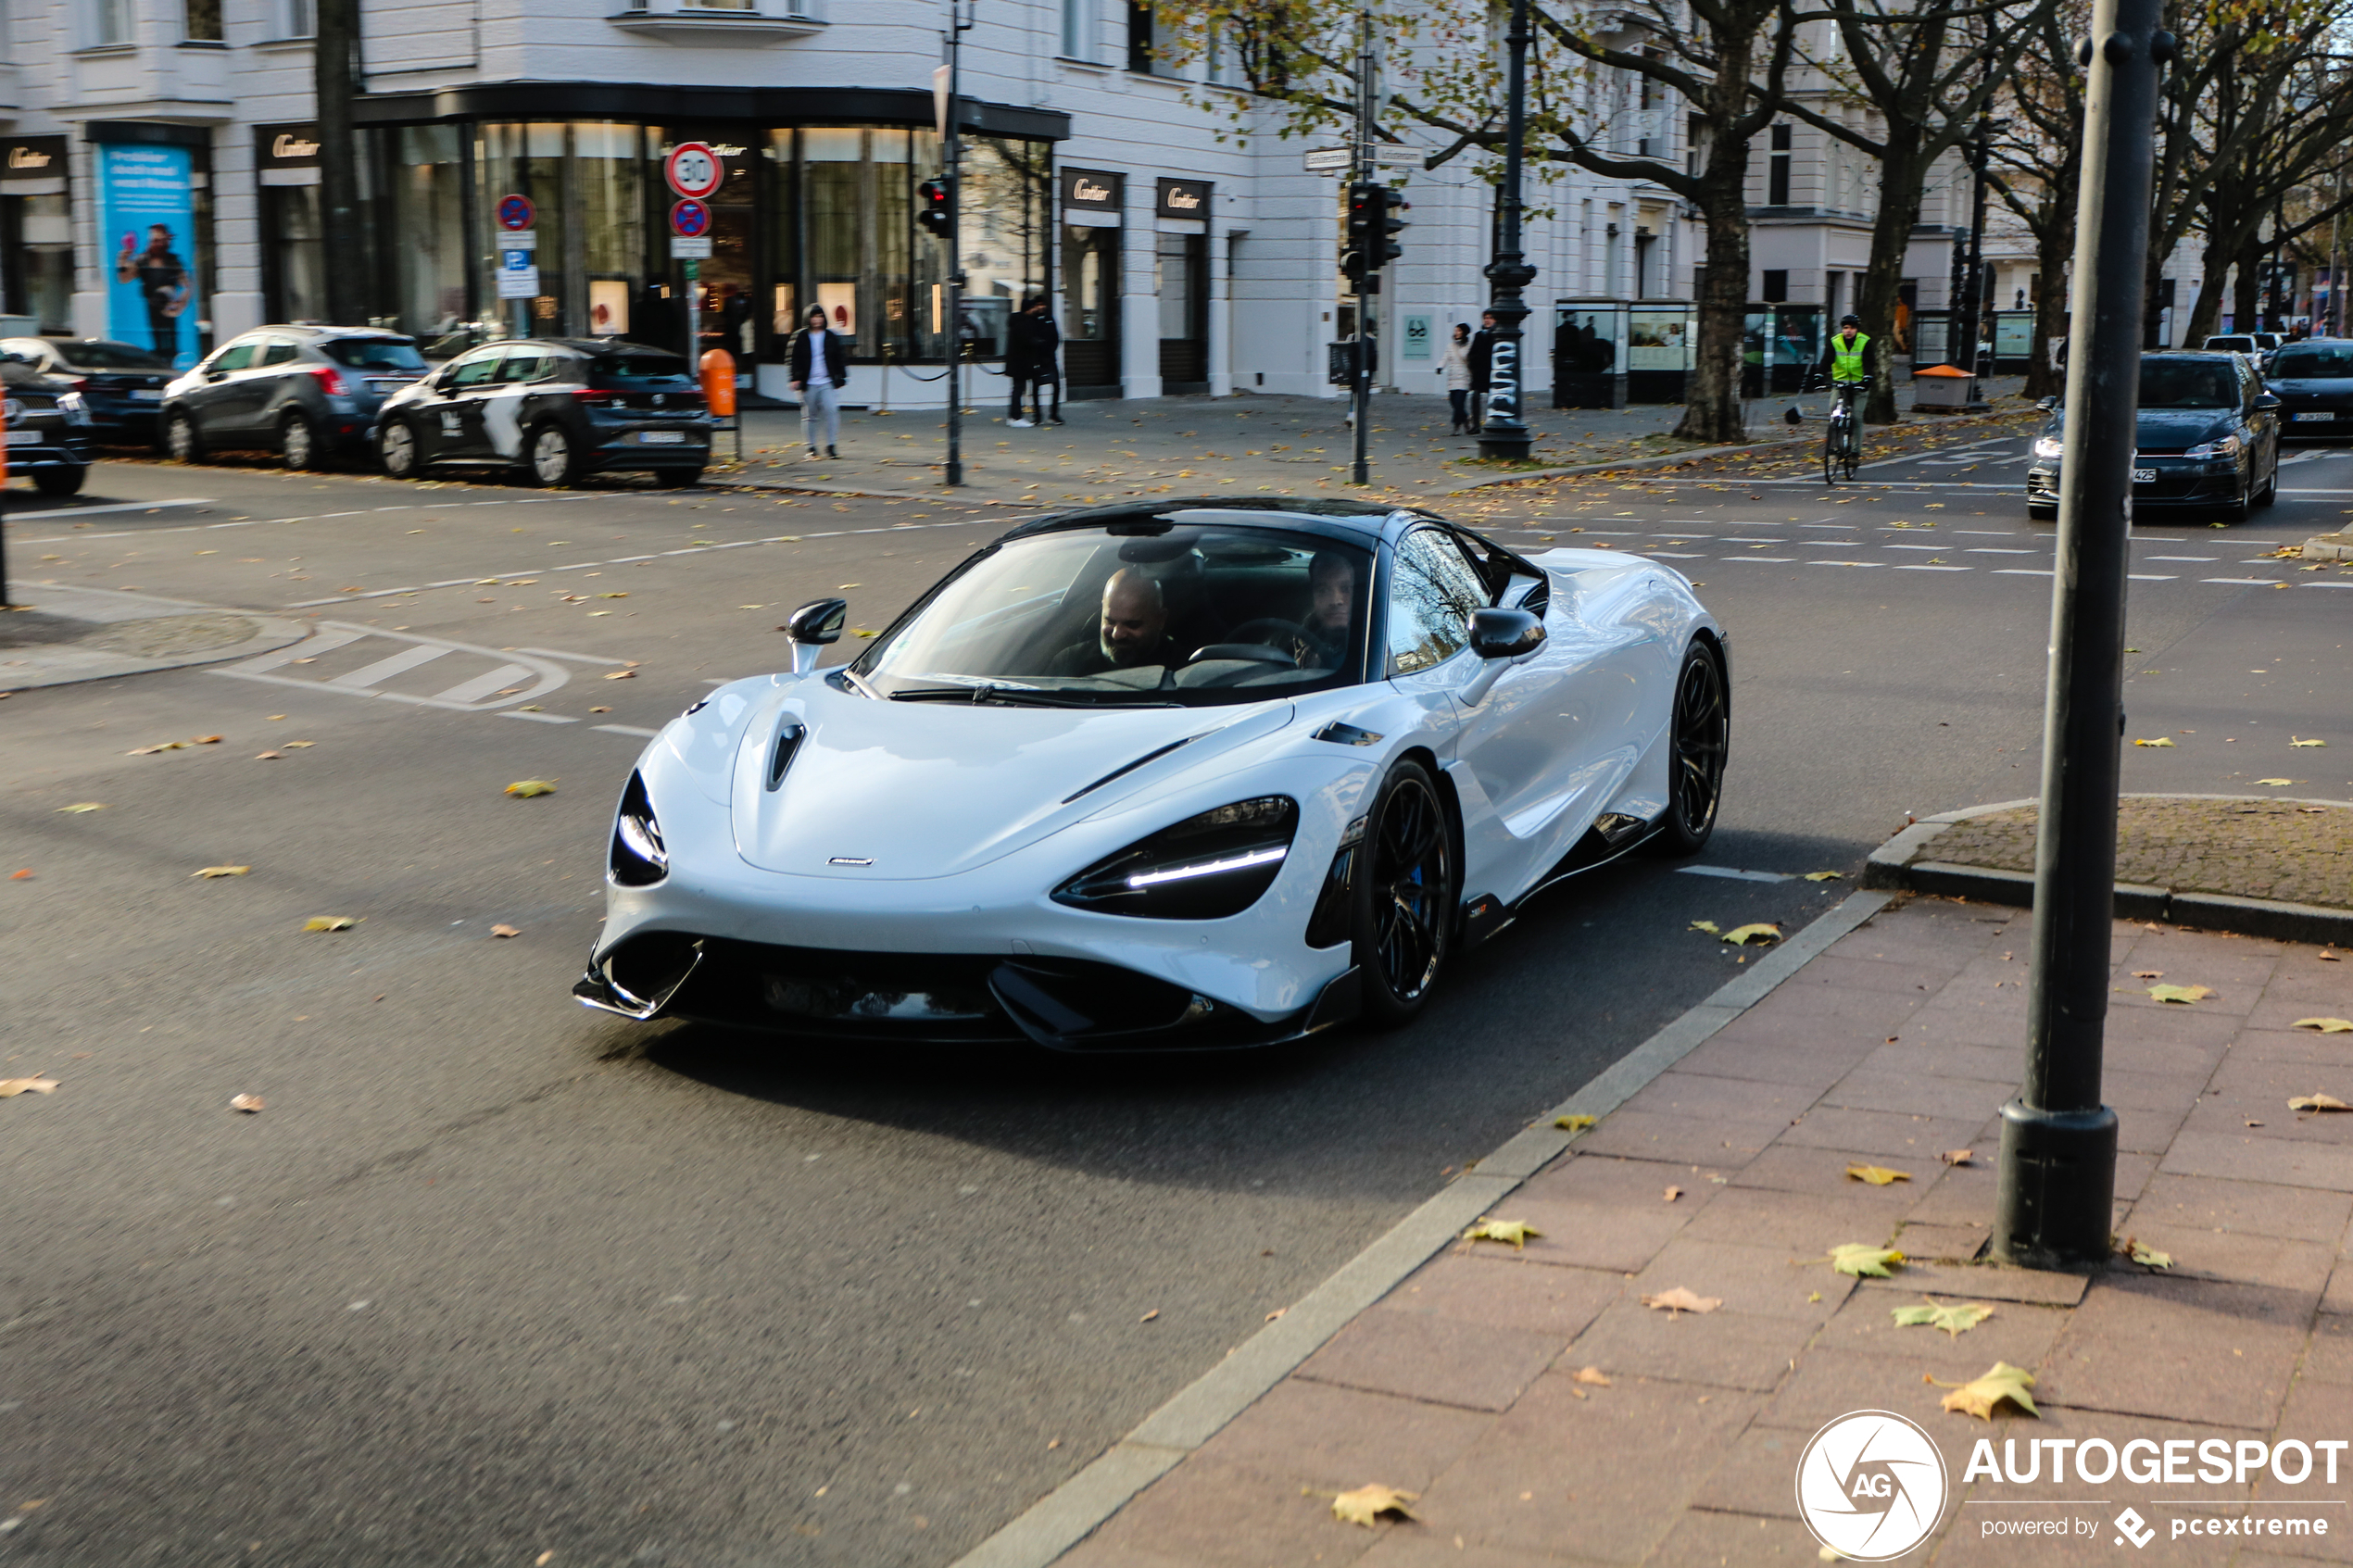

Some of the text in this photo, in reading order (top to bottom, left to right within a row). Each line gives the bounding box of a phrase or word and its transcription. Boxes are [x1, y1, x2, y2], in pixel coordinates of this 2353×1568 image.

[677, 158, 711, 182] 30
[1073, 178, 1111, 201] Cartier
[1167, 187, 1201, 209] Cartier
[2134, 470, 2156, 481] 425
